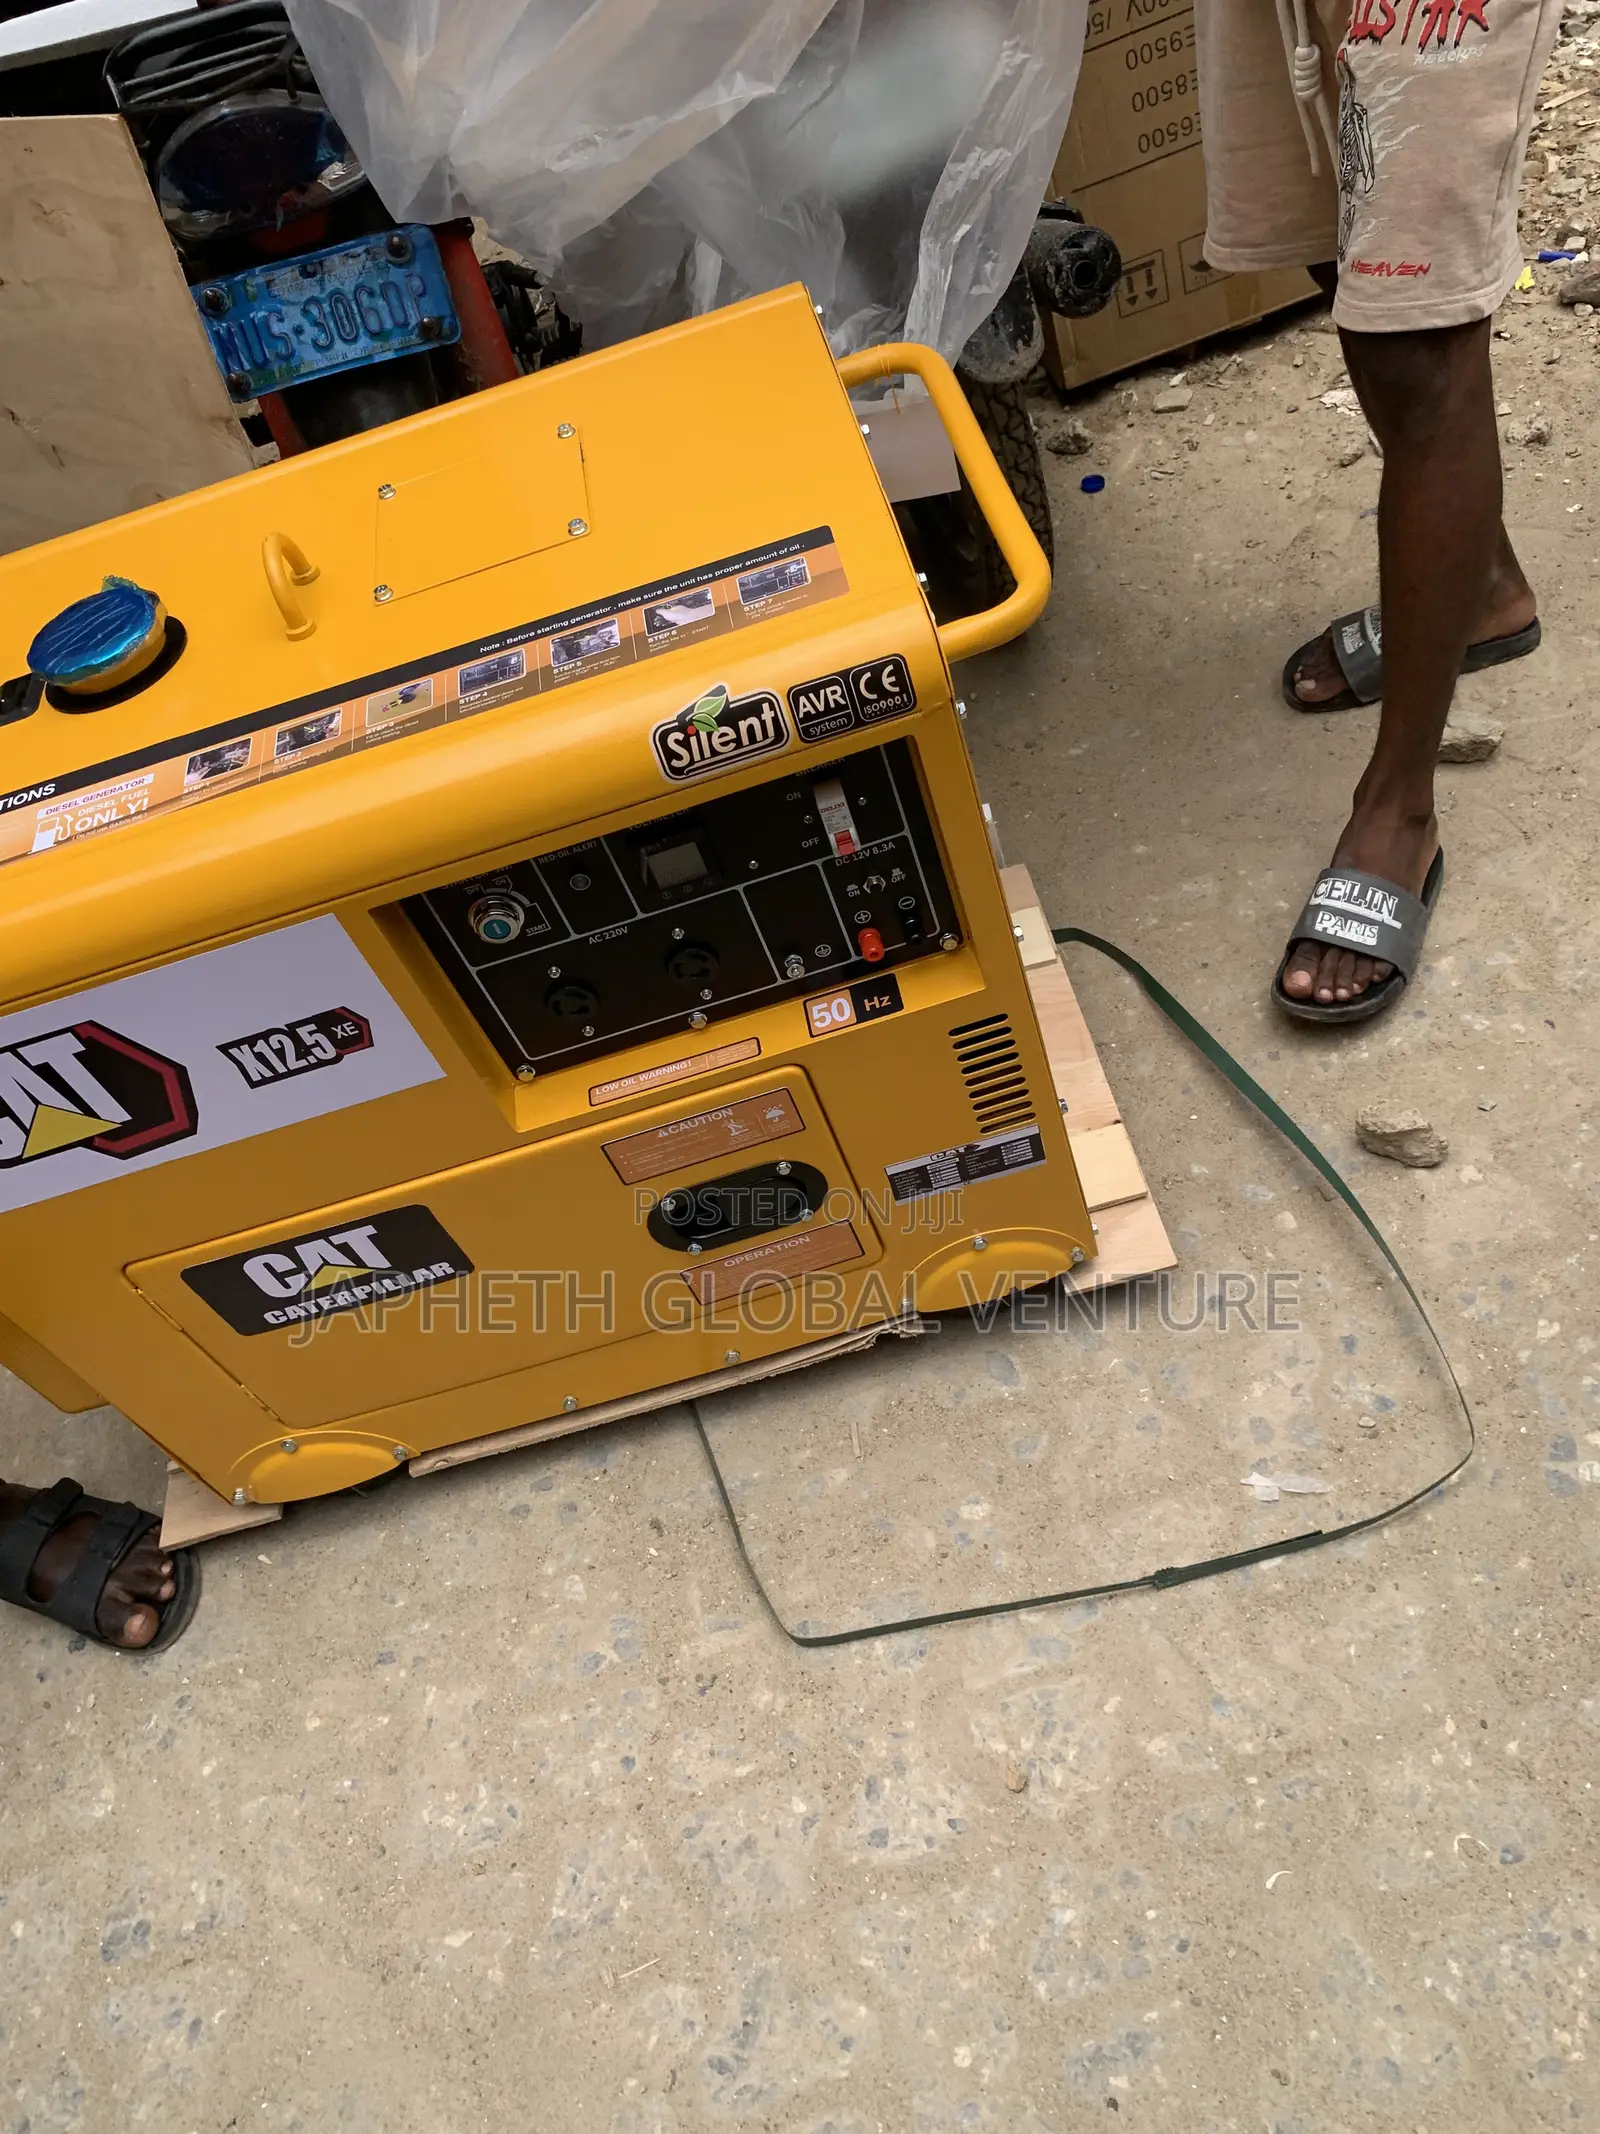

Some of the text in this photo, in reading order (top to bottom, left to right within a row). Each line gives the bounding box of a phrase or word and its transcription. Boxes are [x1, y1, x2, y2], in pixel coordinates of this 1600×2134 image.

[1351, 259, 1431, 277] HEAVEN
[480, 642, 500, 653] Note
[506, 631, 535, 645] Before
[537, 620, 569, 635] starting
[570, 605, 612, 625] generator
[617, 596, 642, 607] make
[643, 589, 663, 599] sure
[664, 582, 678, 593] the
[680, 577, 696, 588] unit
[697, 572, 713, 582] has
[715, 562, 743, 577] proper
[745, 551, 778, 566] amount
[779, 547, 788, 556] of
[789, 543, 800, 552] oil
[743, 600, 767, 612] STEP
[648, 632, 670, 643] STEP
[553, 662, 575, 674] STEP
[859, 664, 900, 700] CE
[459, 693, 481, 705] STEP
[798, 685, 846, 718] AVR
[863, 694, 909, 715] ISO9001
[366, 723, 388, 735] STEP
[666, 702, 776, 769] Silent
[810, 716, 848, 736] system
[45, 778, 146, 815] DIESEL GENERATOR
[78, 788, 150, 817] DIESEL FUEL
[786, 792, 802, 801] ON
[802, 837, 820, 848] OFF
[835, 841, 896, 867] DC 12V 8.3A
[891, 873, 907, 883] OFF
[848, 890, 861, 898] ON
[525, 923, 547, 934] START
[589, 926, 628, 944] AC 220V
[1315, 911, 1378, 945] PARIS
[811, 995, 892, 1028] 50 Hz
[228, 1021, 359, 1082] X12.5 XE
[595, 1059, 692, 1095] LOW OIL WARNING!
[0, 1032, 132, 1160] AT
[668, 1108, 734, 1134] CAUTION
[243, 1224, 392, 1298] CAT
[724, 1235, 811, 1267] OPERATION
[263, 1261, 455, 1325] CATERPILLAR
